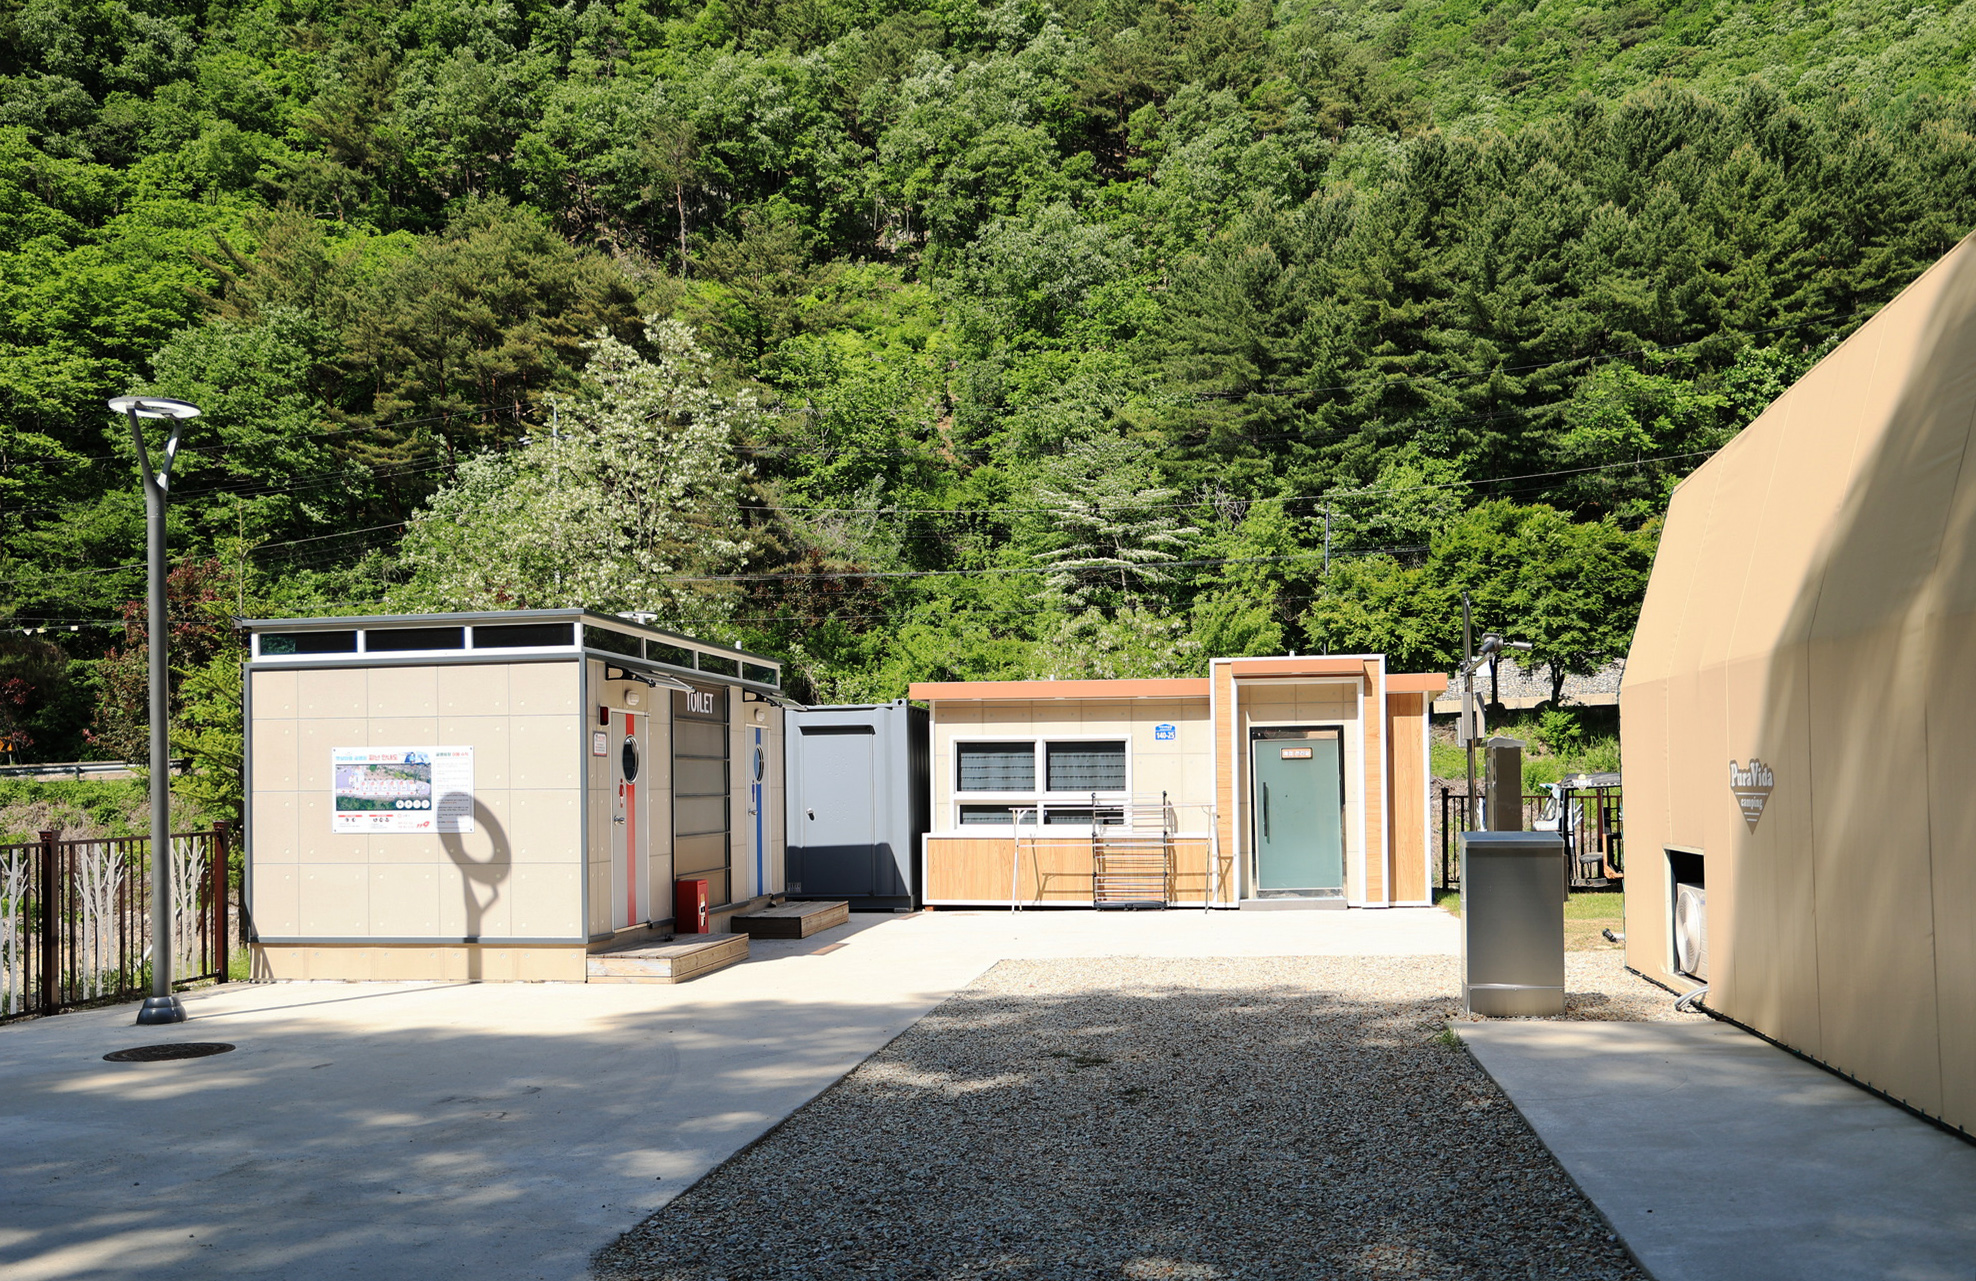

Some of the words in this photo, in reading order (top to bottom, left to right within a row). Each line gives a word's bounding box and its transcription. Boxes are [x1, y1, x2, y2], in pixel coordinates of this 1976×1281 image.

[686, 691, 714, 714] TOILET
[1156, 731, 1175, 739] 140-25
[1740, 796, 1763, 810] camping
